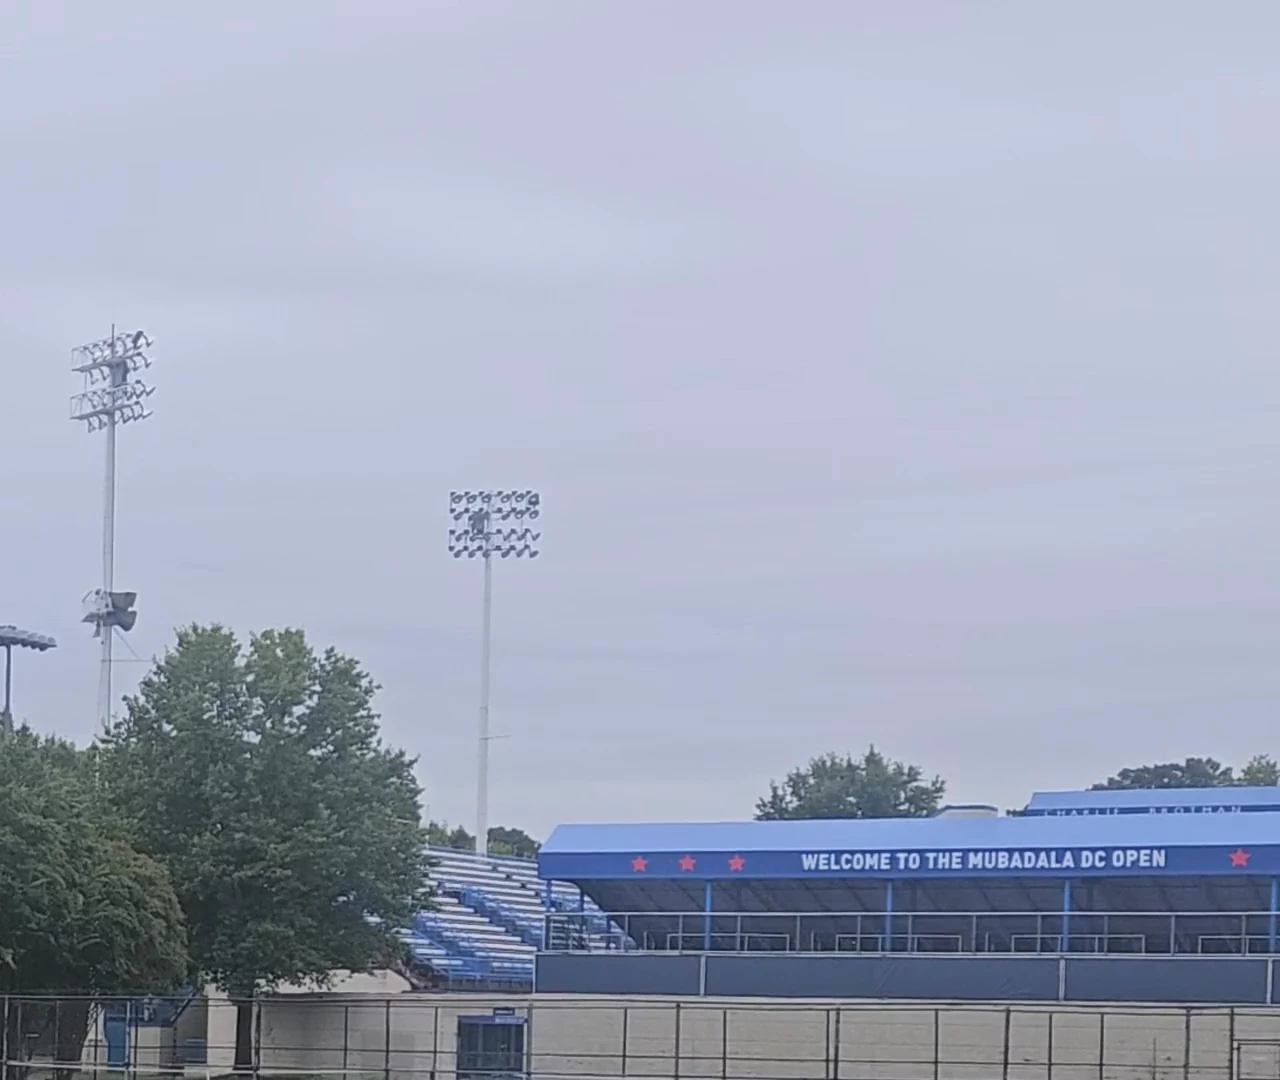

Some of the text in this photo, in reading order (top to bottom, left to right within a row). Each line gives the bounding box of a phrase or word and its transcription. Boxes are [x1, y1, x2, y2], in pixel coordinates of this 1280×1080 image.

[801, 849, 1166, 871] WELCOME TO THE MUBADALA DC OPEN
